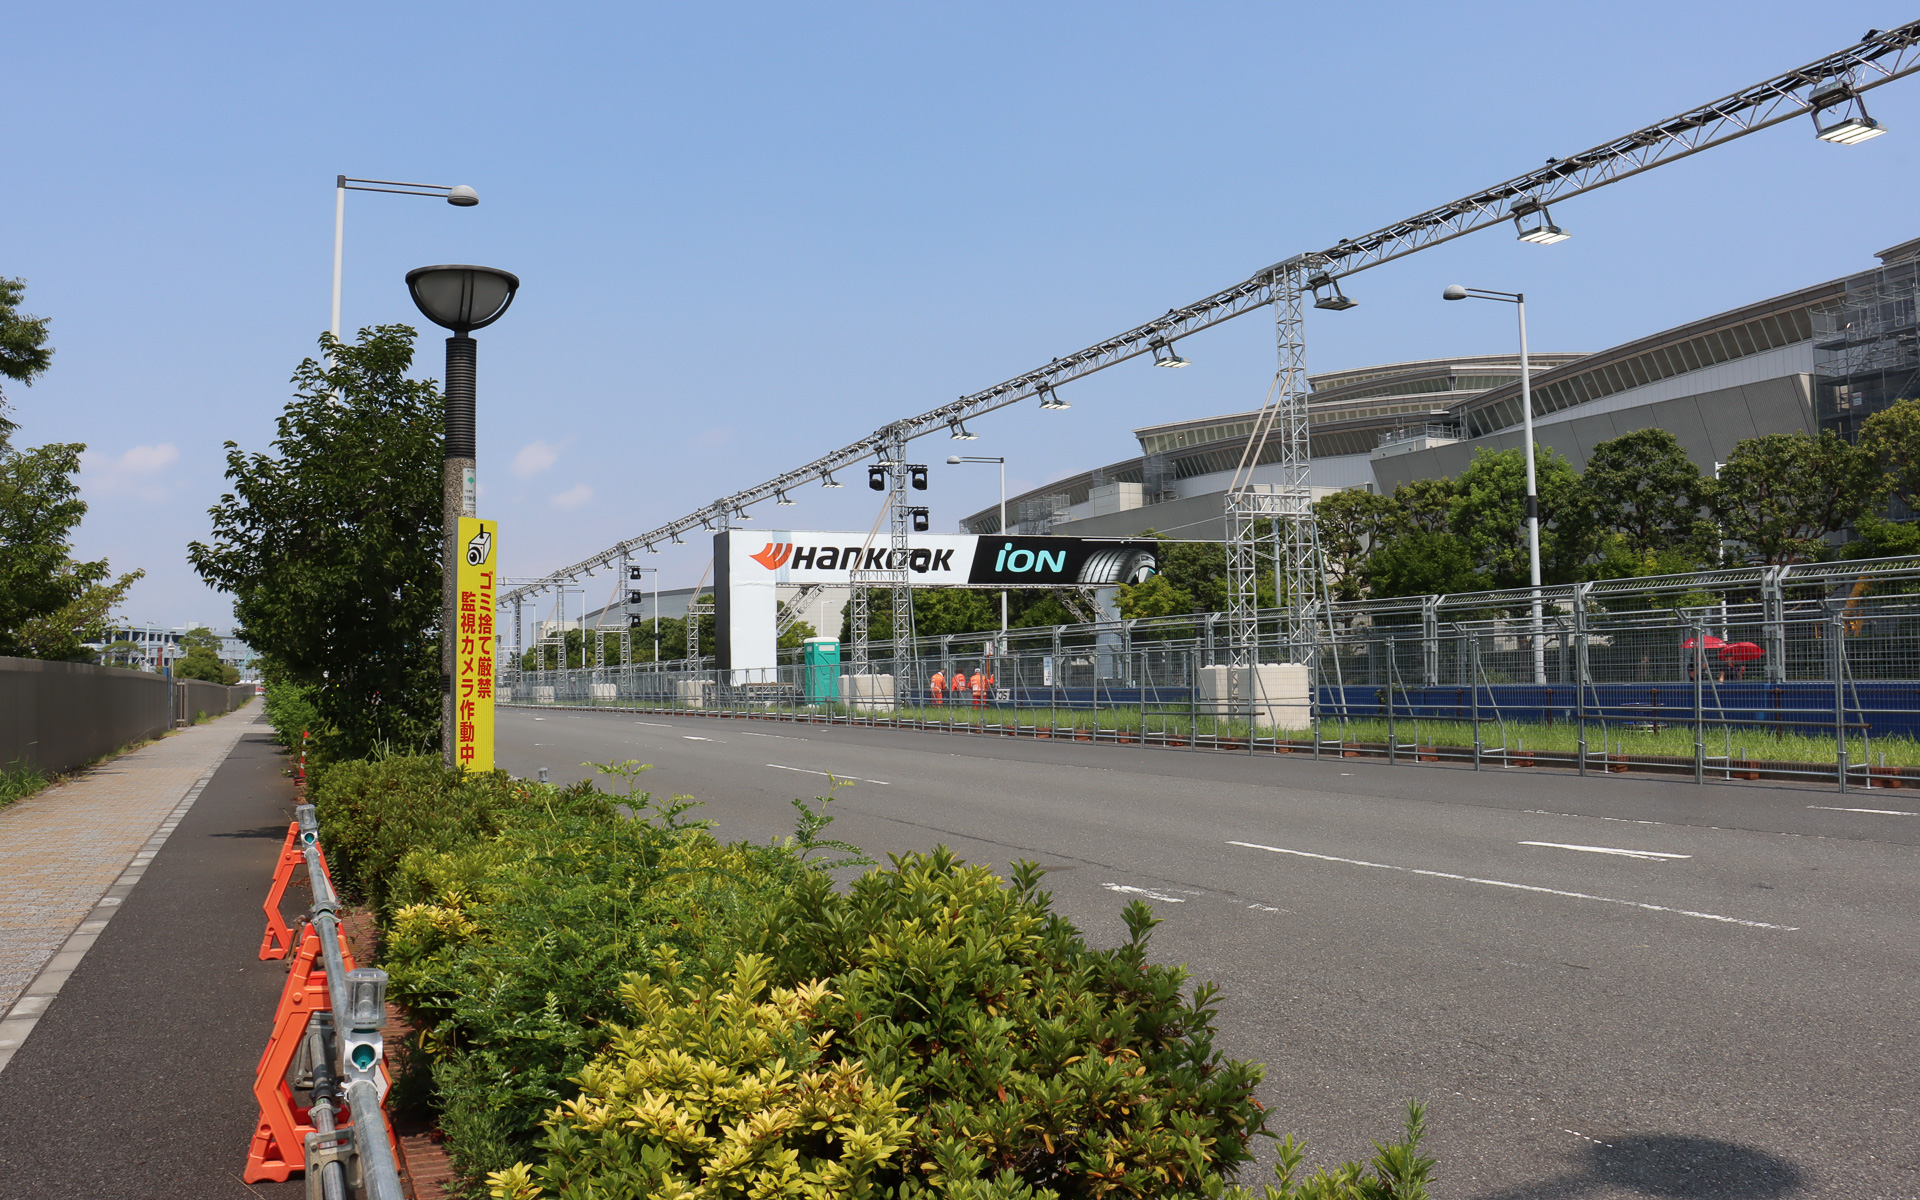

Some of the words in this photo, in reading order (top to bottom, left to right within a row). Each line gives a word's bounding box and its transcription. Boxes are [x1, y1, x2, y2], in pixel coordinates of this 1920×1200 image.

[459, 591, 476, 765] 監視カメラ作動中
[477, 571, 493, 699] ゴミ捨て厳禁
